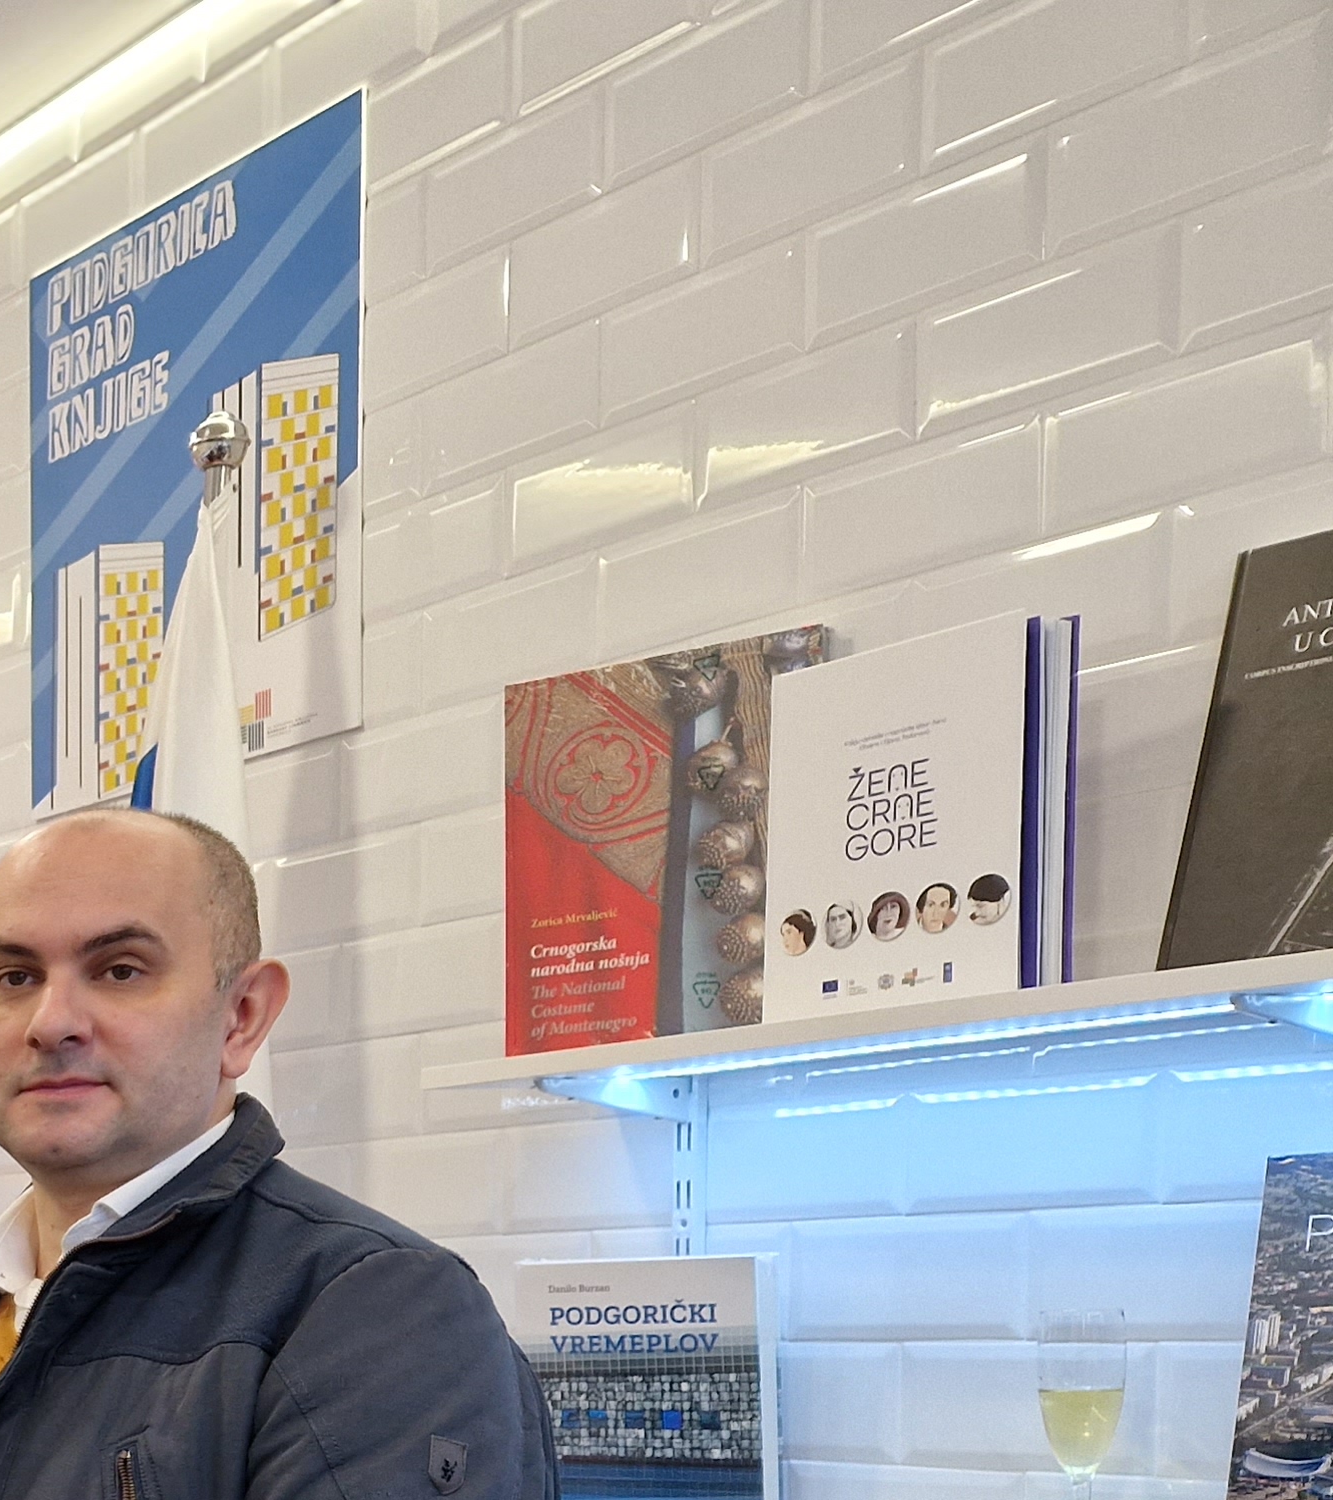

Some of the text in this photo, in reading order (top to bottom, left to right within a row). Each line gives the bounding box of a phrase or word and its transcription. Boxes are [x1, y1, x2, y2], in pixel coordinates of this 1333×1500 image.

[47, 180, 237, 336] PODGORICA
[47, 304, 134, 400] GRAD
[48, 350, 169, 464] KNJIGE
[1294, 631, 1315, 653] U
[847, 758, 930, 802] ŽENE
[846, 788, 935, 831] CRNE
[845, 818, 939, 861] GORE
[531, 907, 618, 928] Zorica Mrvaljević
[531, 935, 617, 959] Crnogorska
[531, 951, 650, 978] narodna nošnja
[532, 975, 626, 999] The National
[531, 1001, 595, 1019] Costume
[531, 1016, 637, 1040] of Montenegro
[548, 1284, 611, 1294] Danilo Burzan
[549, 1298, 718, 1326] PODGORIČKI
[549, 1333, 720, 1355] VREMEPLOV
